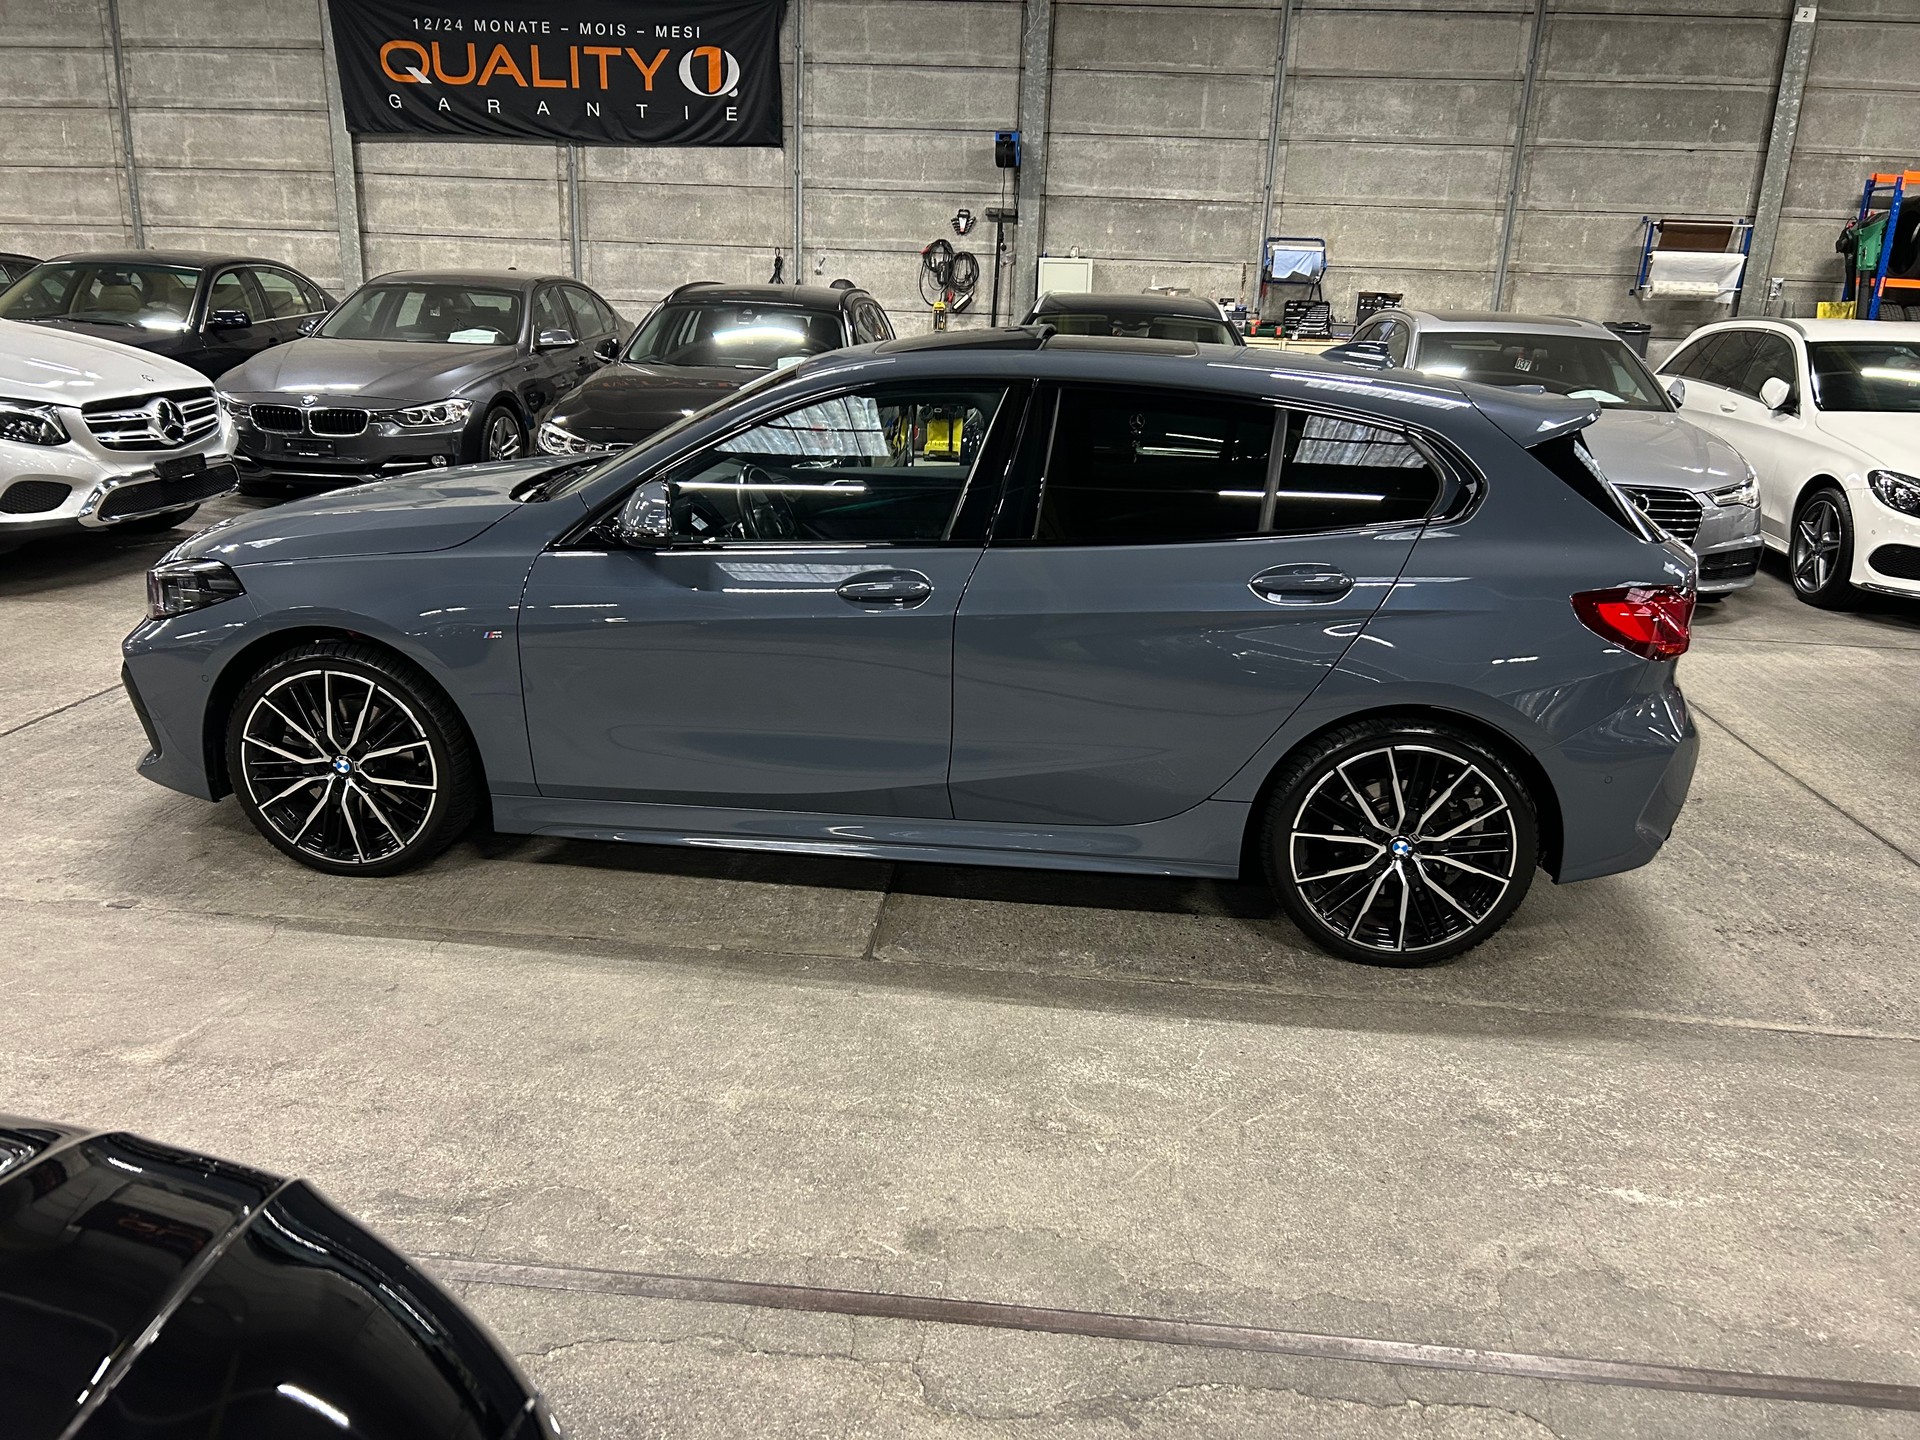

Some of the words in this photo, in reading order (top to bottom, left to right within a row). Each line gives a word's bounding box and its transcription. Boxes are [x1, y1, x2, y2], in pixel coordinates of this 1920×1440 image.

[1802, 10, 1809, 18] 2
[412, 17, 463, 31] 12/24
[473, 19, 551, 34] MONATE
[579, 22, 626, 36] MOIS
[655, 25, 700, 38] MESI
[379, 39, 671, 92] QUALITY
[388, 93, 738, 121] GARANTIE
